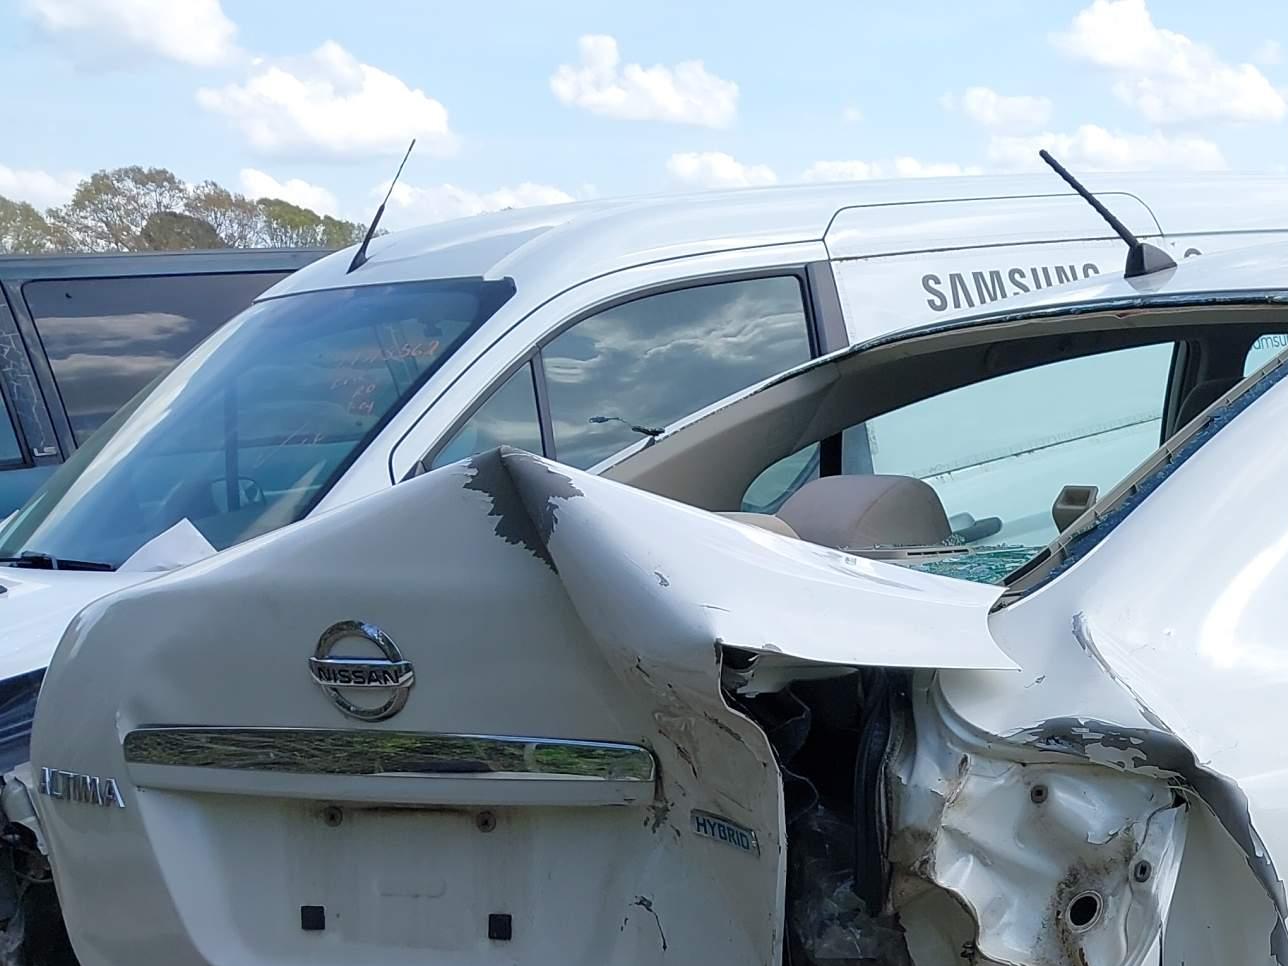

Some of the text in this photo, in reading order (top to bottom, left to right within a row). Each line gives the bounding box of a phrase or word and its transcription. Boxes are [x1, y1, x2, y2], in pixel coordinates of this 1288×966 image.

[318, 667, 401, 685] NISSAN
[40, 766, 126, 808] ALTIMA
[695, 816, 750, 850] HYBRID
